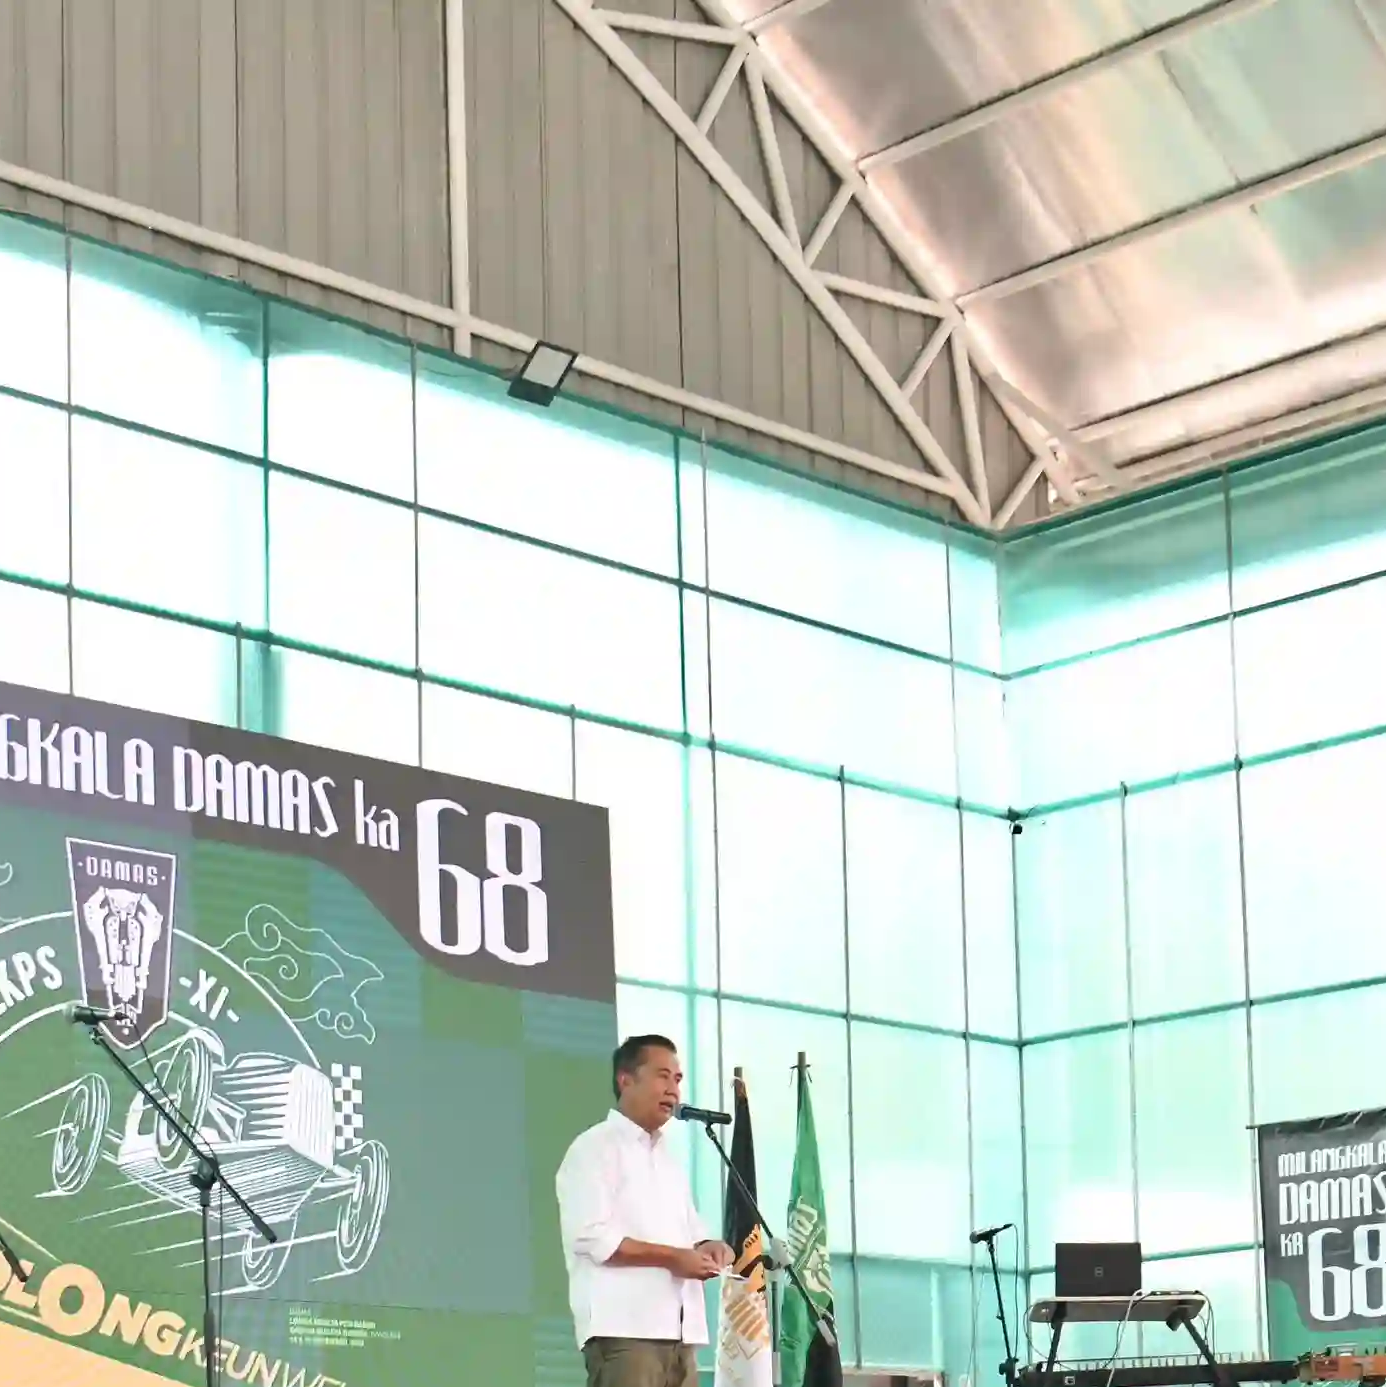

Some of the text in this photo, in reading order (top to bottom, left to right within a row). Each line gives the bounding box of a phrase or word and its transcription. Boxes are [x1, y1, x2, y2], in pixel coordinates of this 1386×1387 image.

[86, 855, 158, 886] DAMAS
[173, 745, 339, 838] DAMAS
[354, 778, 400, 851] ka
[416, 798, 549, 966] 68
[1280, 1231, 1304, 1258] KA
